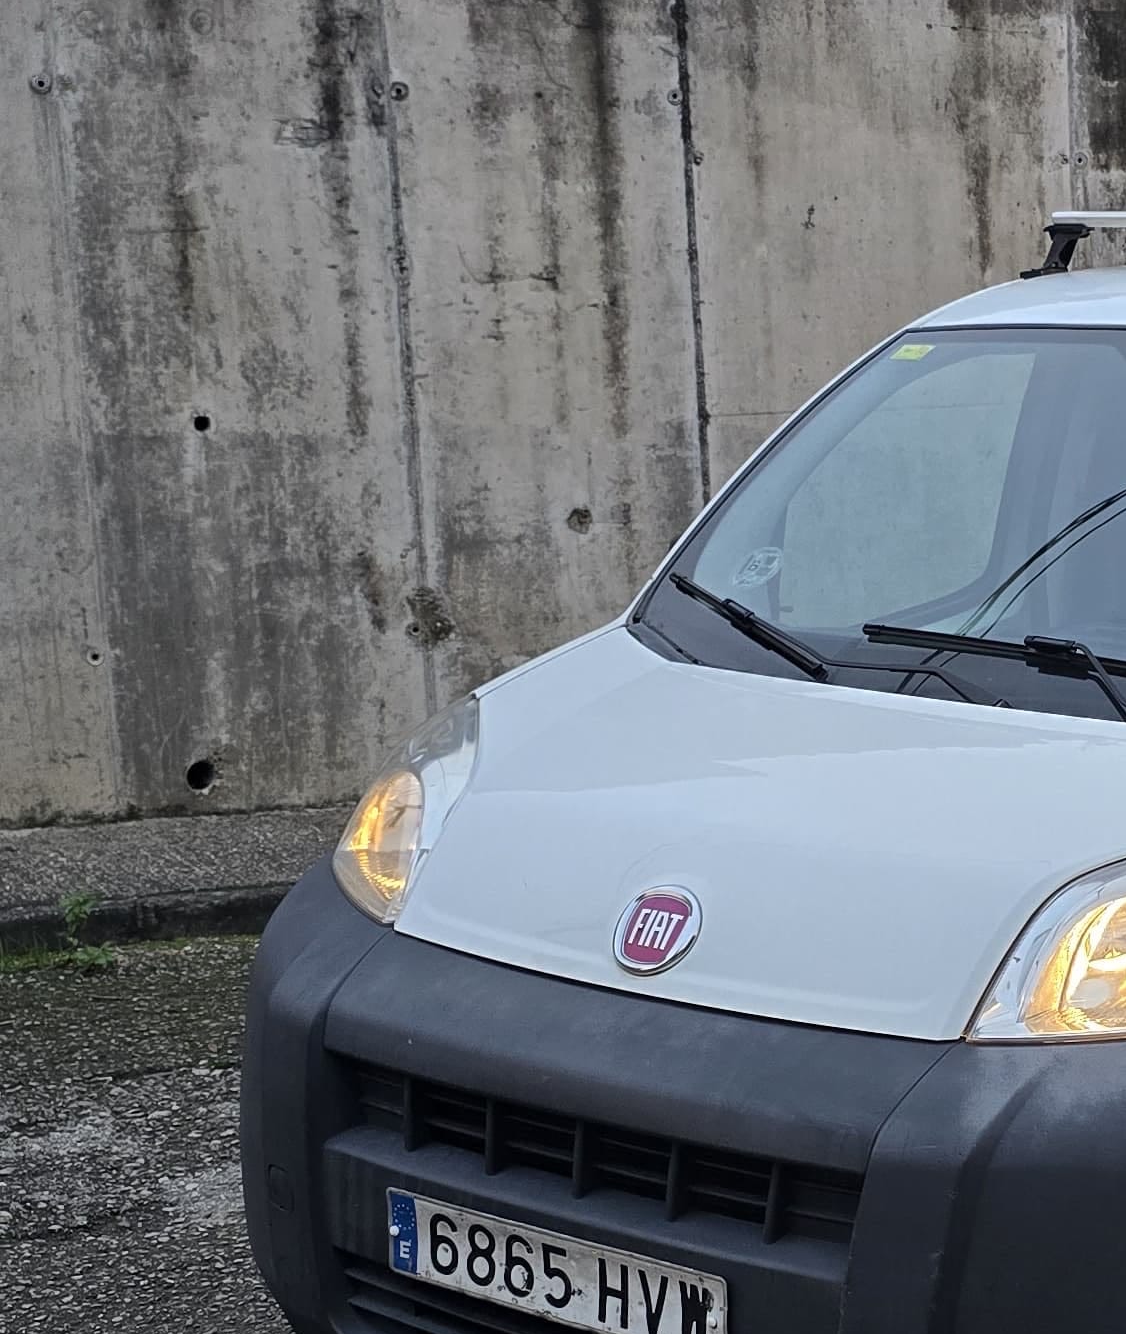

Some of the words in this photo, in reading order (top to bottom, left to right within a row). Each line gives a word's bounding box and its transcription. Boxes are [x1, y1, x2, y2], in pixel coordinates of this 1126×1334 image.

[627, 908, 685, 951] FIAT
[399, 1240, 411, 1259] E
[429, 1214, 573, 1308] 6865
